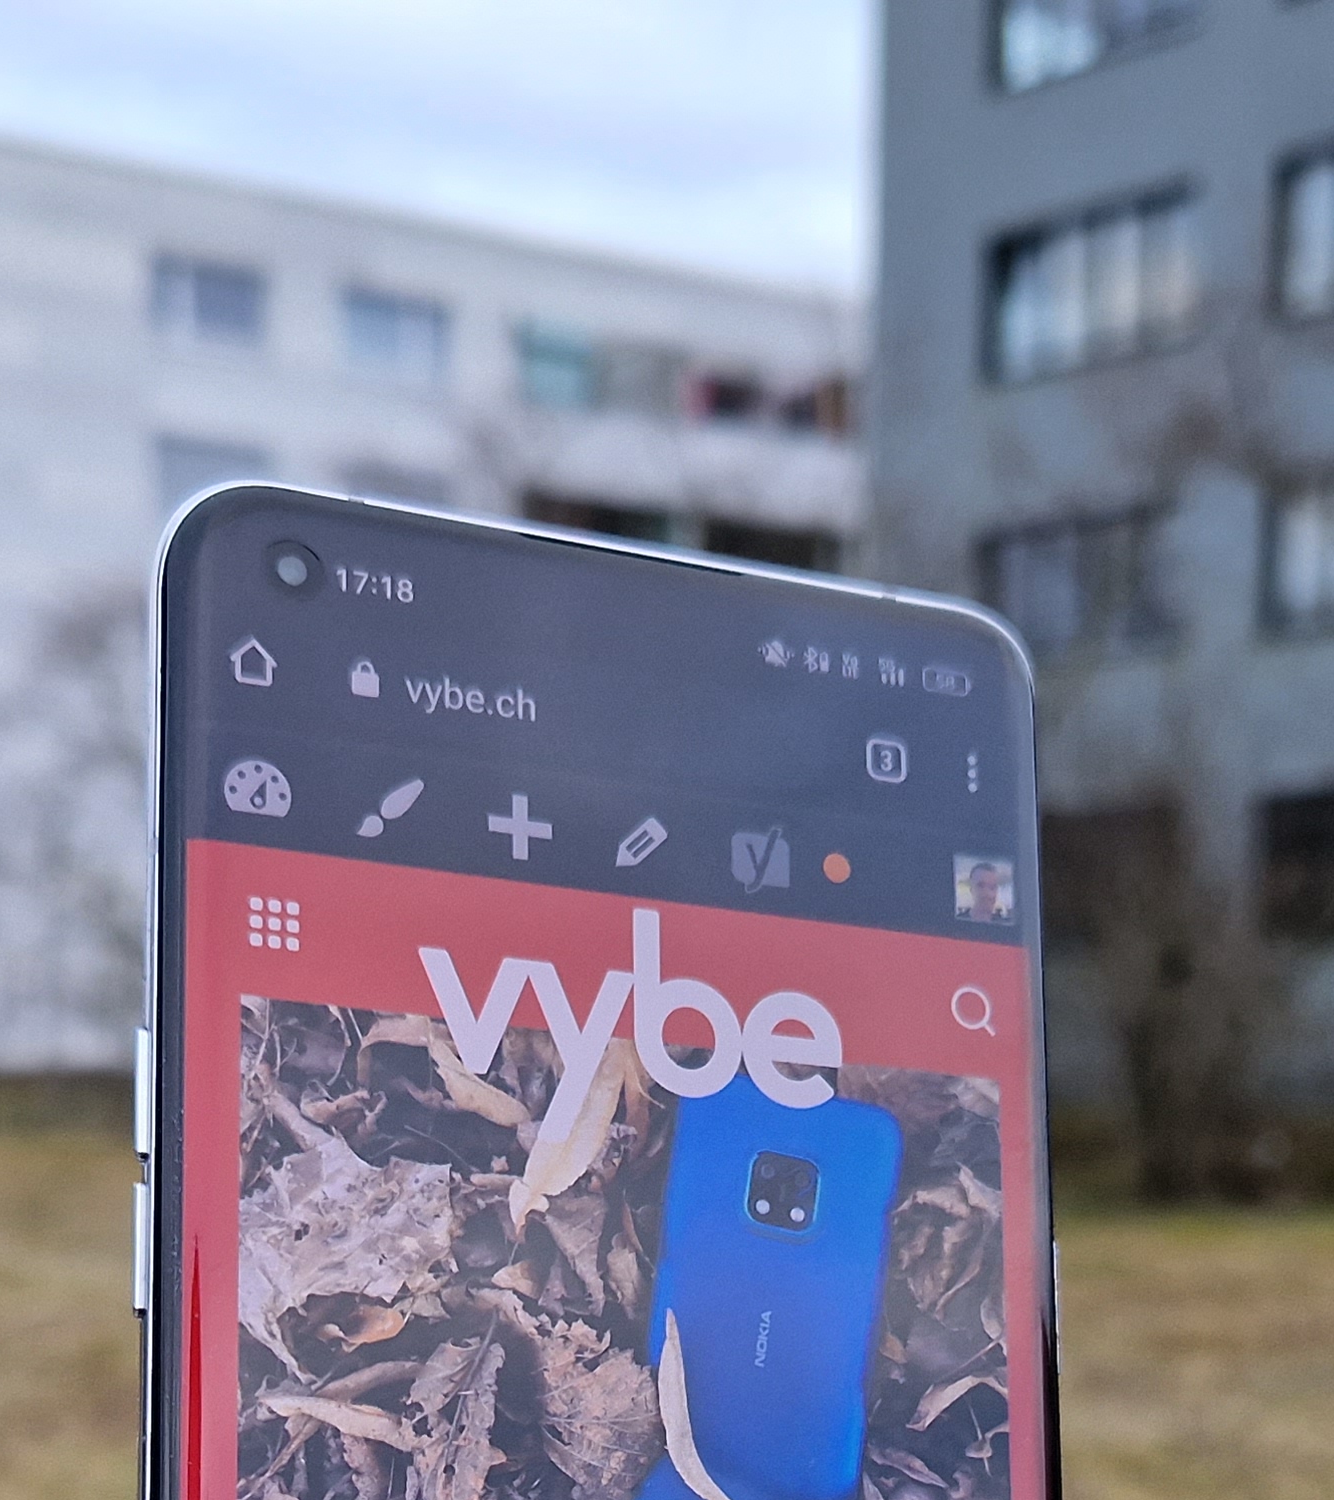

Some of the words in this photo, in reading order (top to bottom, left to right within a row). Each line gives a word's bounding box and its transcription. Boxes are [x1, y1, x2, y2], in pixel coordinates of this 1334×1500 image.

[336, 567, 415, 603] 17:18
[404, 675, 537, 723] vybe.ch
[879, 750, 893, 772] 3
[418, 907, 843, 1143] vybe
[754, 1310, 772, 1369] NOKIA
